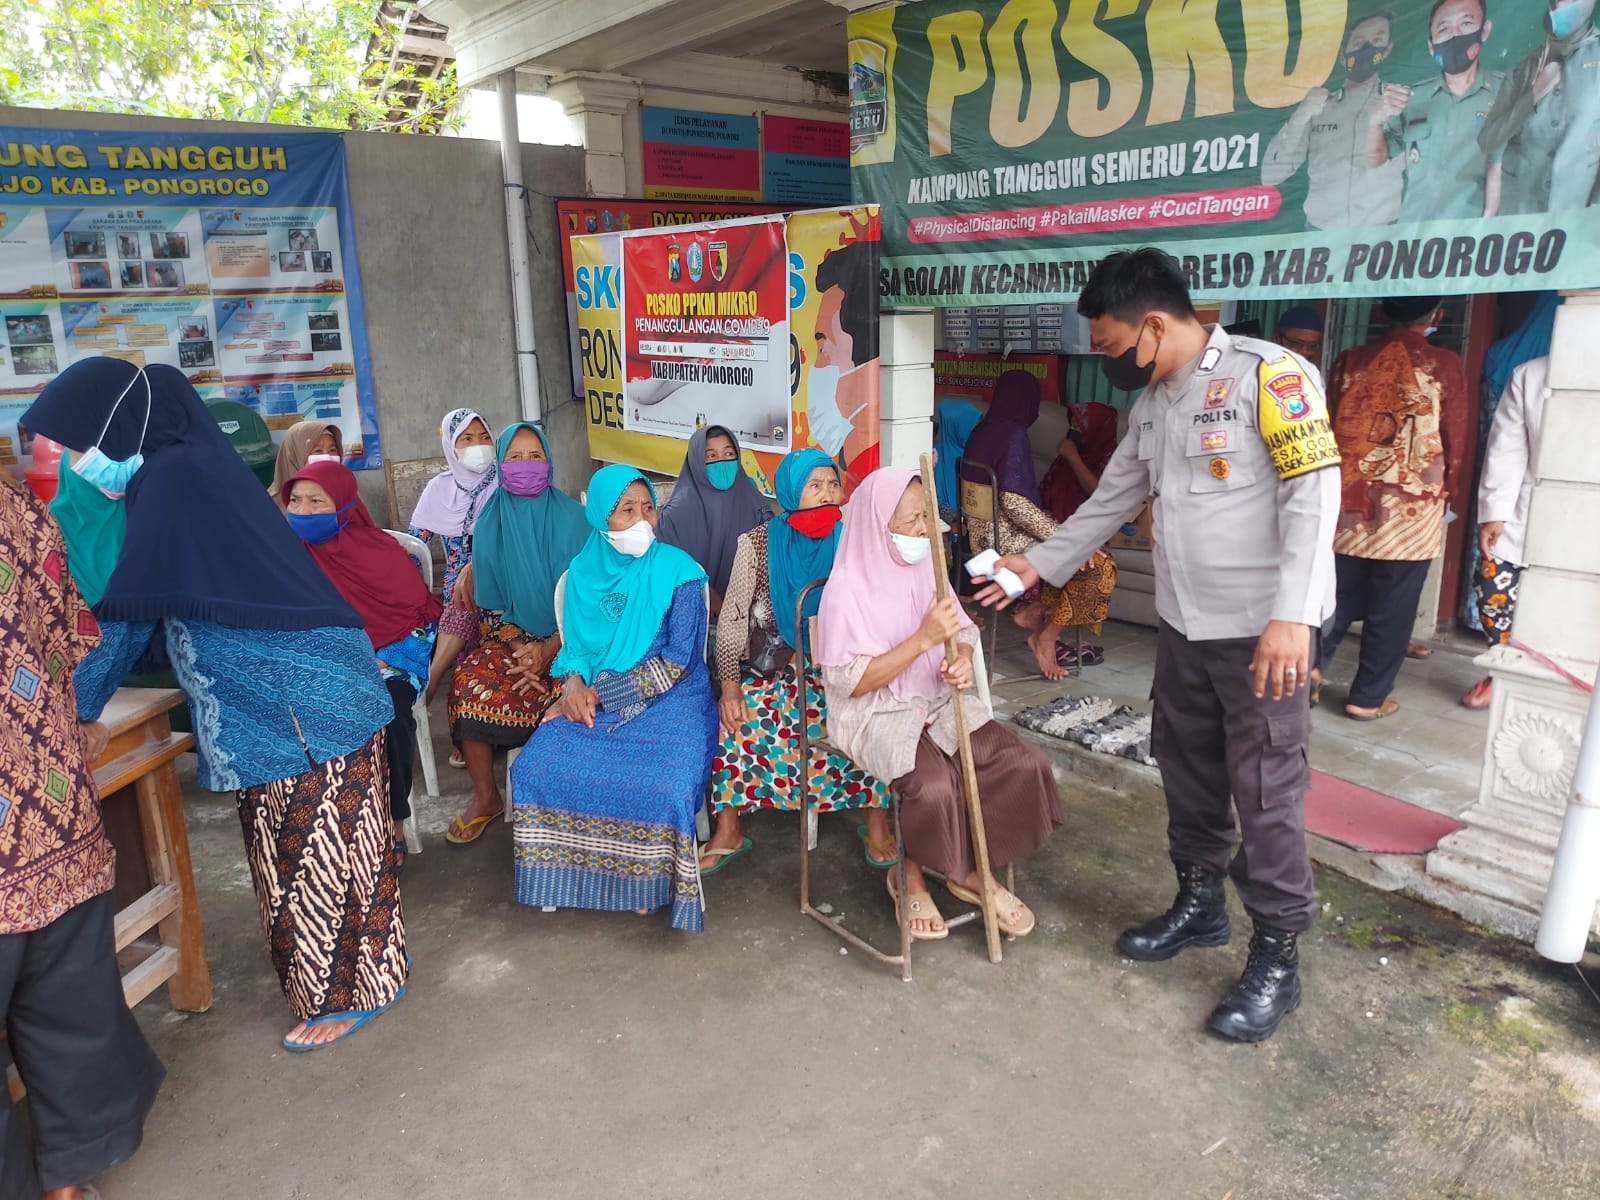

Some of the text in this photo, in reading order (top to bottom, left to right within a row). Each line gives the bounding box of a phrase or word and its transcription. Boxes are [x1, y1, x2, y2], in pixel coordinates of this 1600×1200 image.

[927, 0, 1347, 158] POSKO
[691, 117, 728, 129] PELAYANAN
[97, 145, 288, 171] TANGGUH
[907, 132, 1260, 204] KAMPUNG TANGGUH SEMERU 2021
[0, 176, 269, 196] JO KAB. PONOROGO
[914, 194, 1269, 236] #PhysicalDistancing #PakaiMasker #CuciTangan
[904, 264, 967, 295] GOLAN
[1170, 252, 1254, 290] REJO
[1259, 247, 1334, 286] KAB.
[1344, 229, 1567, 282] PONOROGO
[575, 264, 621, 309] SK
[646, 290, 758, 316] POSKO PPKM MIKRO
[635, 317, 770, 336] PENANGGULANGAN COVID-19
[651, 361, 754, 387] KABUPATEN PONOROGO
[1193, 409, 1238, 426] POLISI
